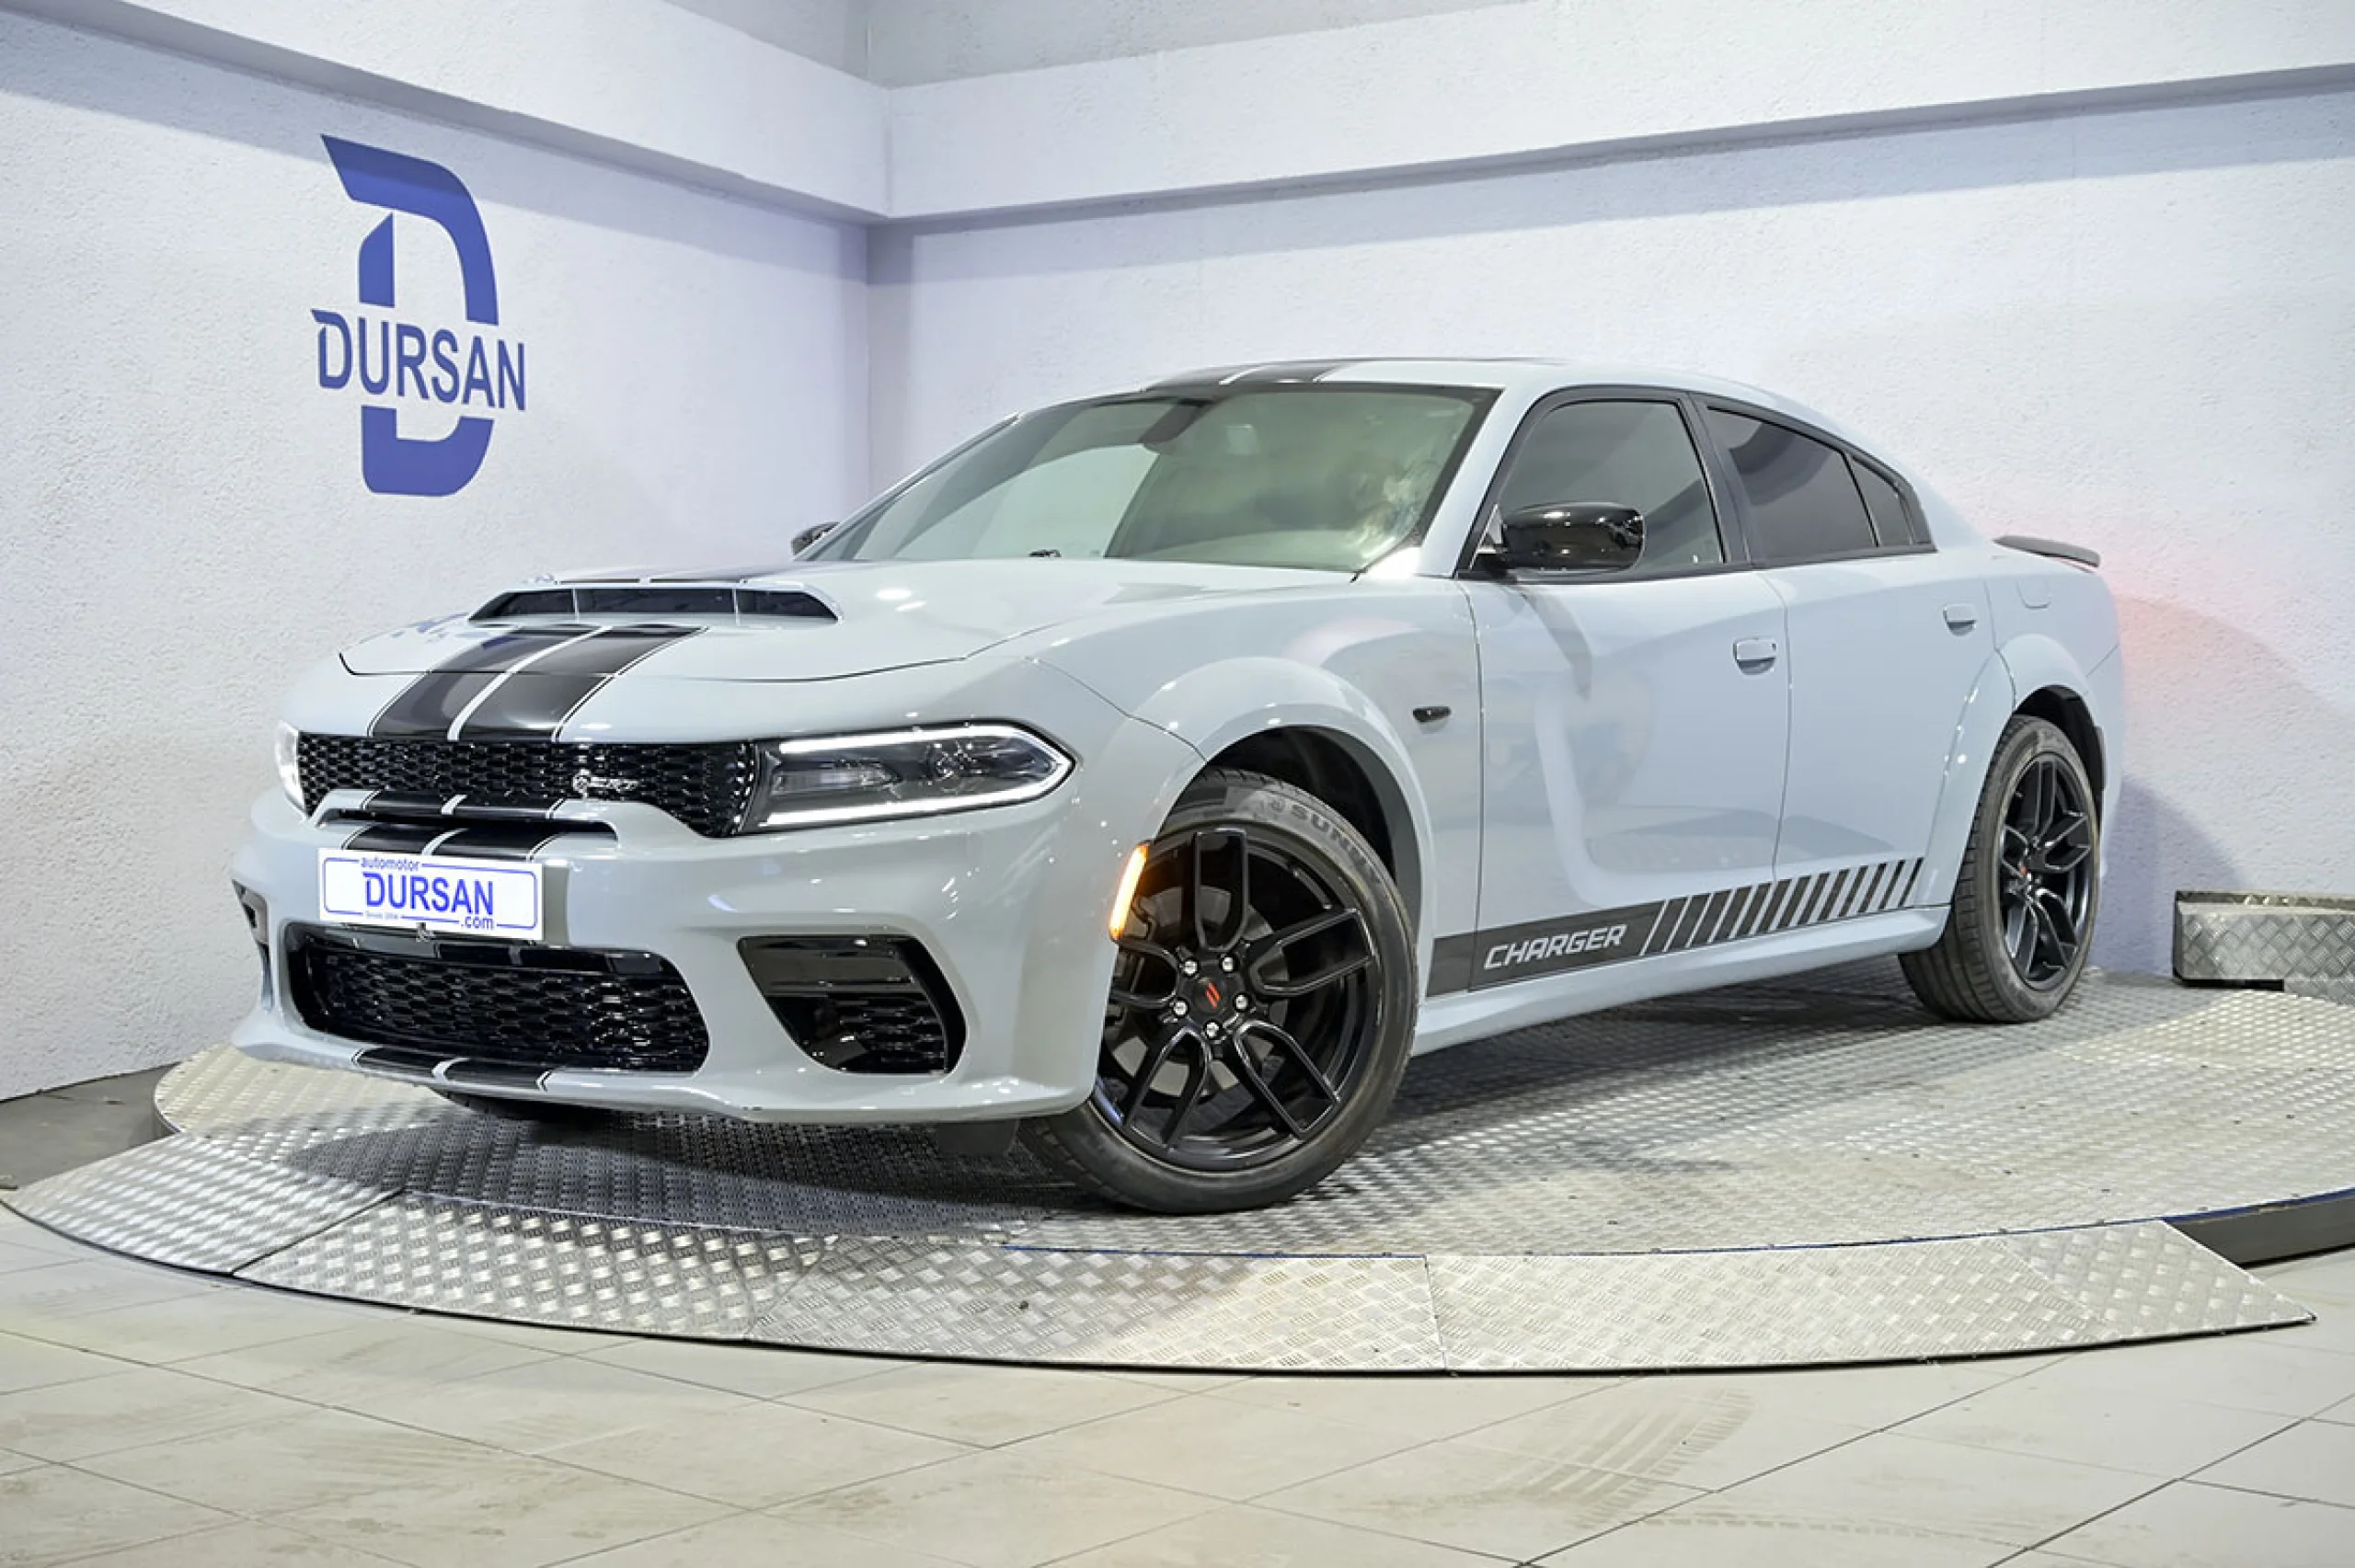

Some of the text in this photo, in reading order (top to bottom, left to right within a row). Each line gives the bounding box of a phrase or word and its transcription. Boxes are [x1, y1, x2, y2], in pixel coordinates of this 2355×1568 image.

[310, 308, 526, 411] DURSAN
[361, 857, 419, 871] automotor
[362, 871, 494, 915] DURSAN
[460, 915, 495, 930] .com
[1483, 923, 1627, 970] CHARGER
